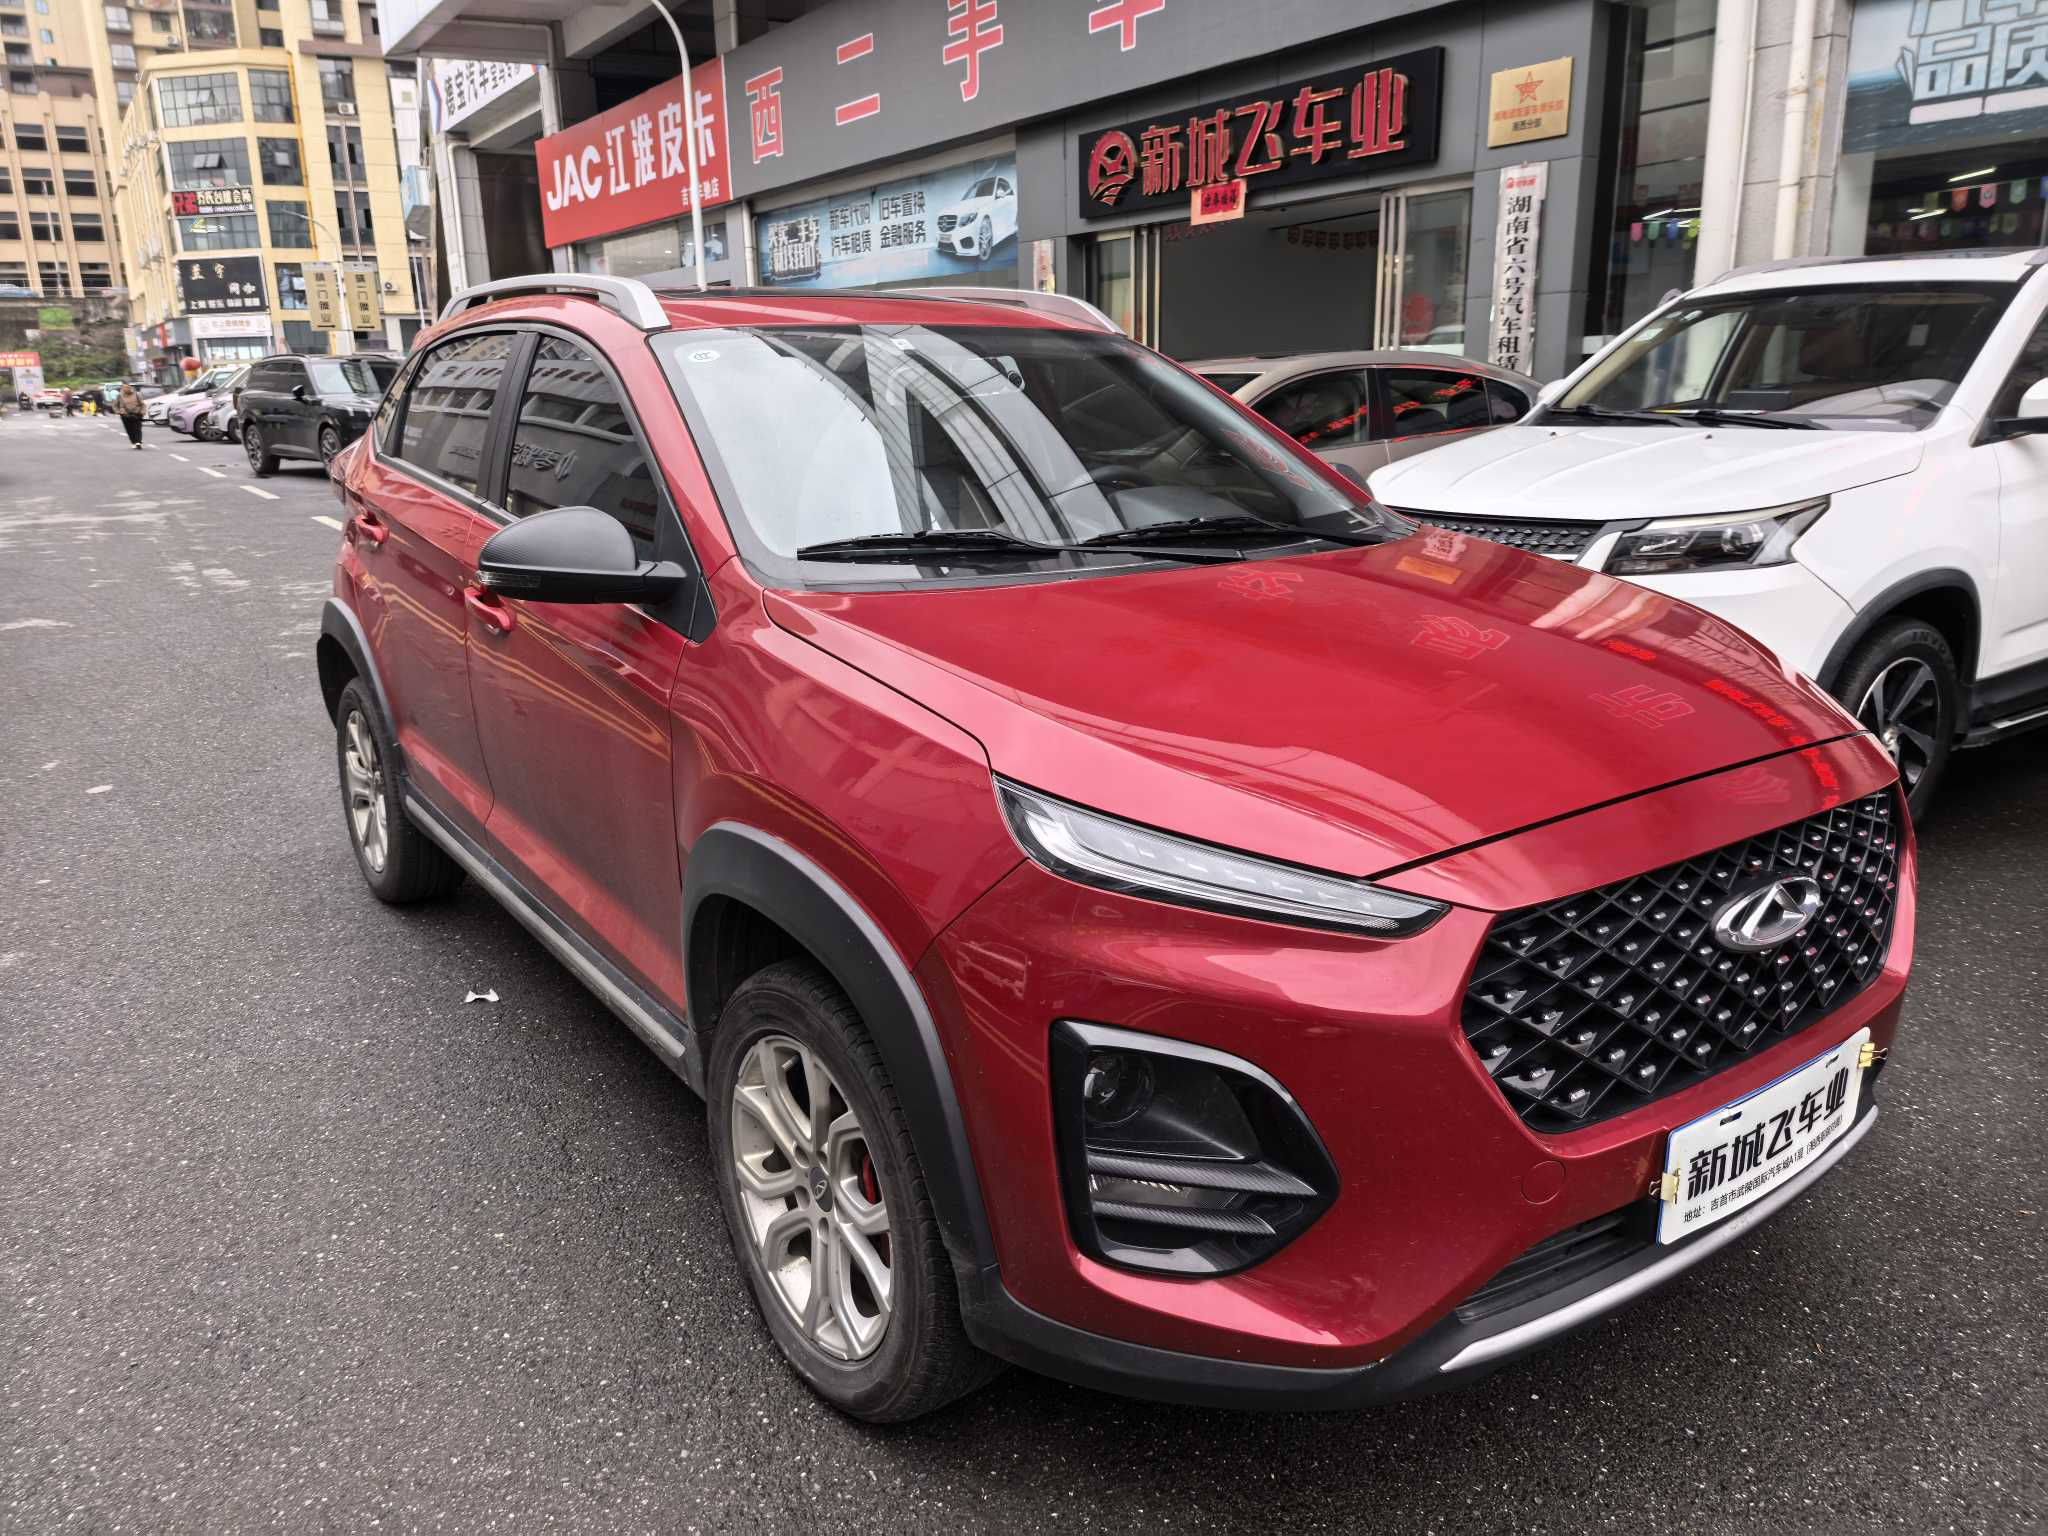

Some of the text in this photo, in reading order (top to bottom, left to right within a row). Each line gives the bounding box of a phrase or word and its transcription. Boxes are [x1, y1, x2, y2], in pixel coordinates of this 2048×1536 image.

[1140, 67, 1409, 196] 新城飞车业
[547, 145, 602, 211] JAC
[830, 191, 926, 231] 新车代购 旧车置换
[831, 220, 926, 256] 汽车租赁 金融服务
[1687, 1067, 1850, 1200] 新城飞车业
